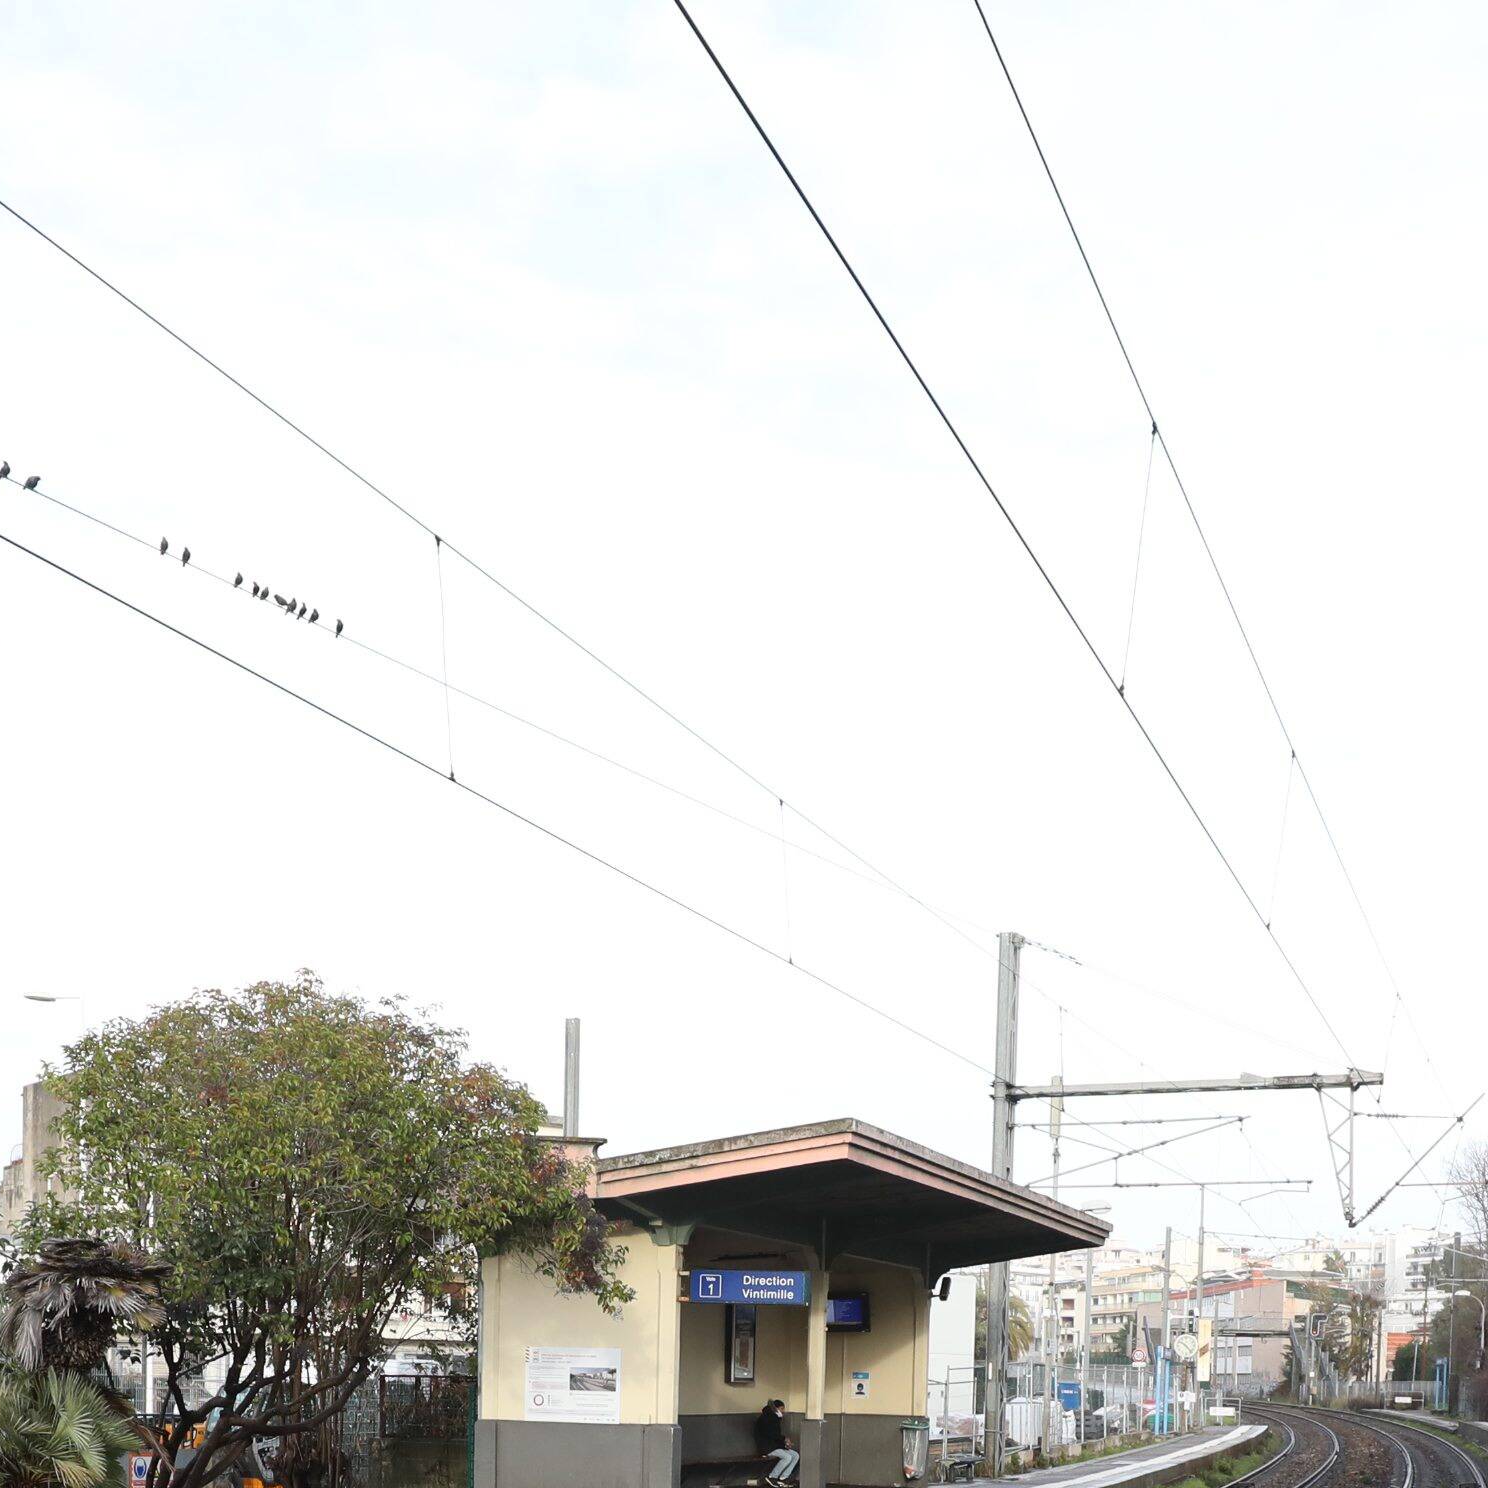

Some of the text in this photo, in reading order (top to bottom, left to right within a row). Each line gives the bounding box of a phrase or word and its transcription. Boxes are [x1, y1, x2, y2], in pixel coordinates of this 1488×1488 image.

[743, 1275, 794, 1286] Direction
[708, 1284, 714, 1295] 1
[742, 1289, 794, 1300] Vintimille
